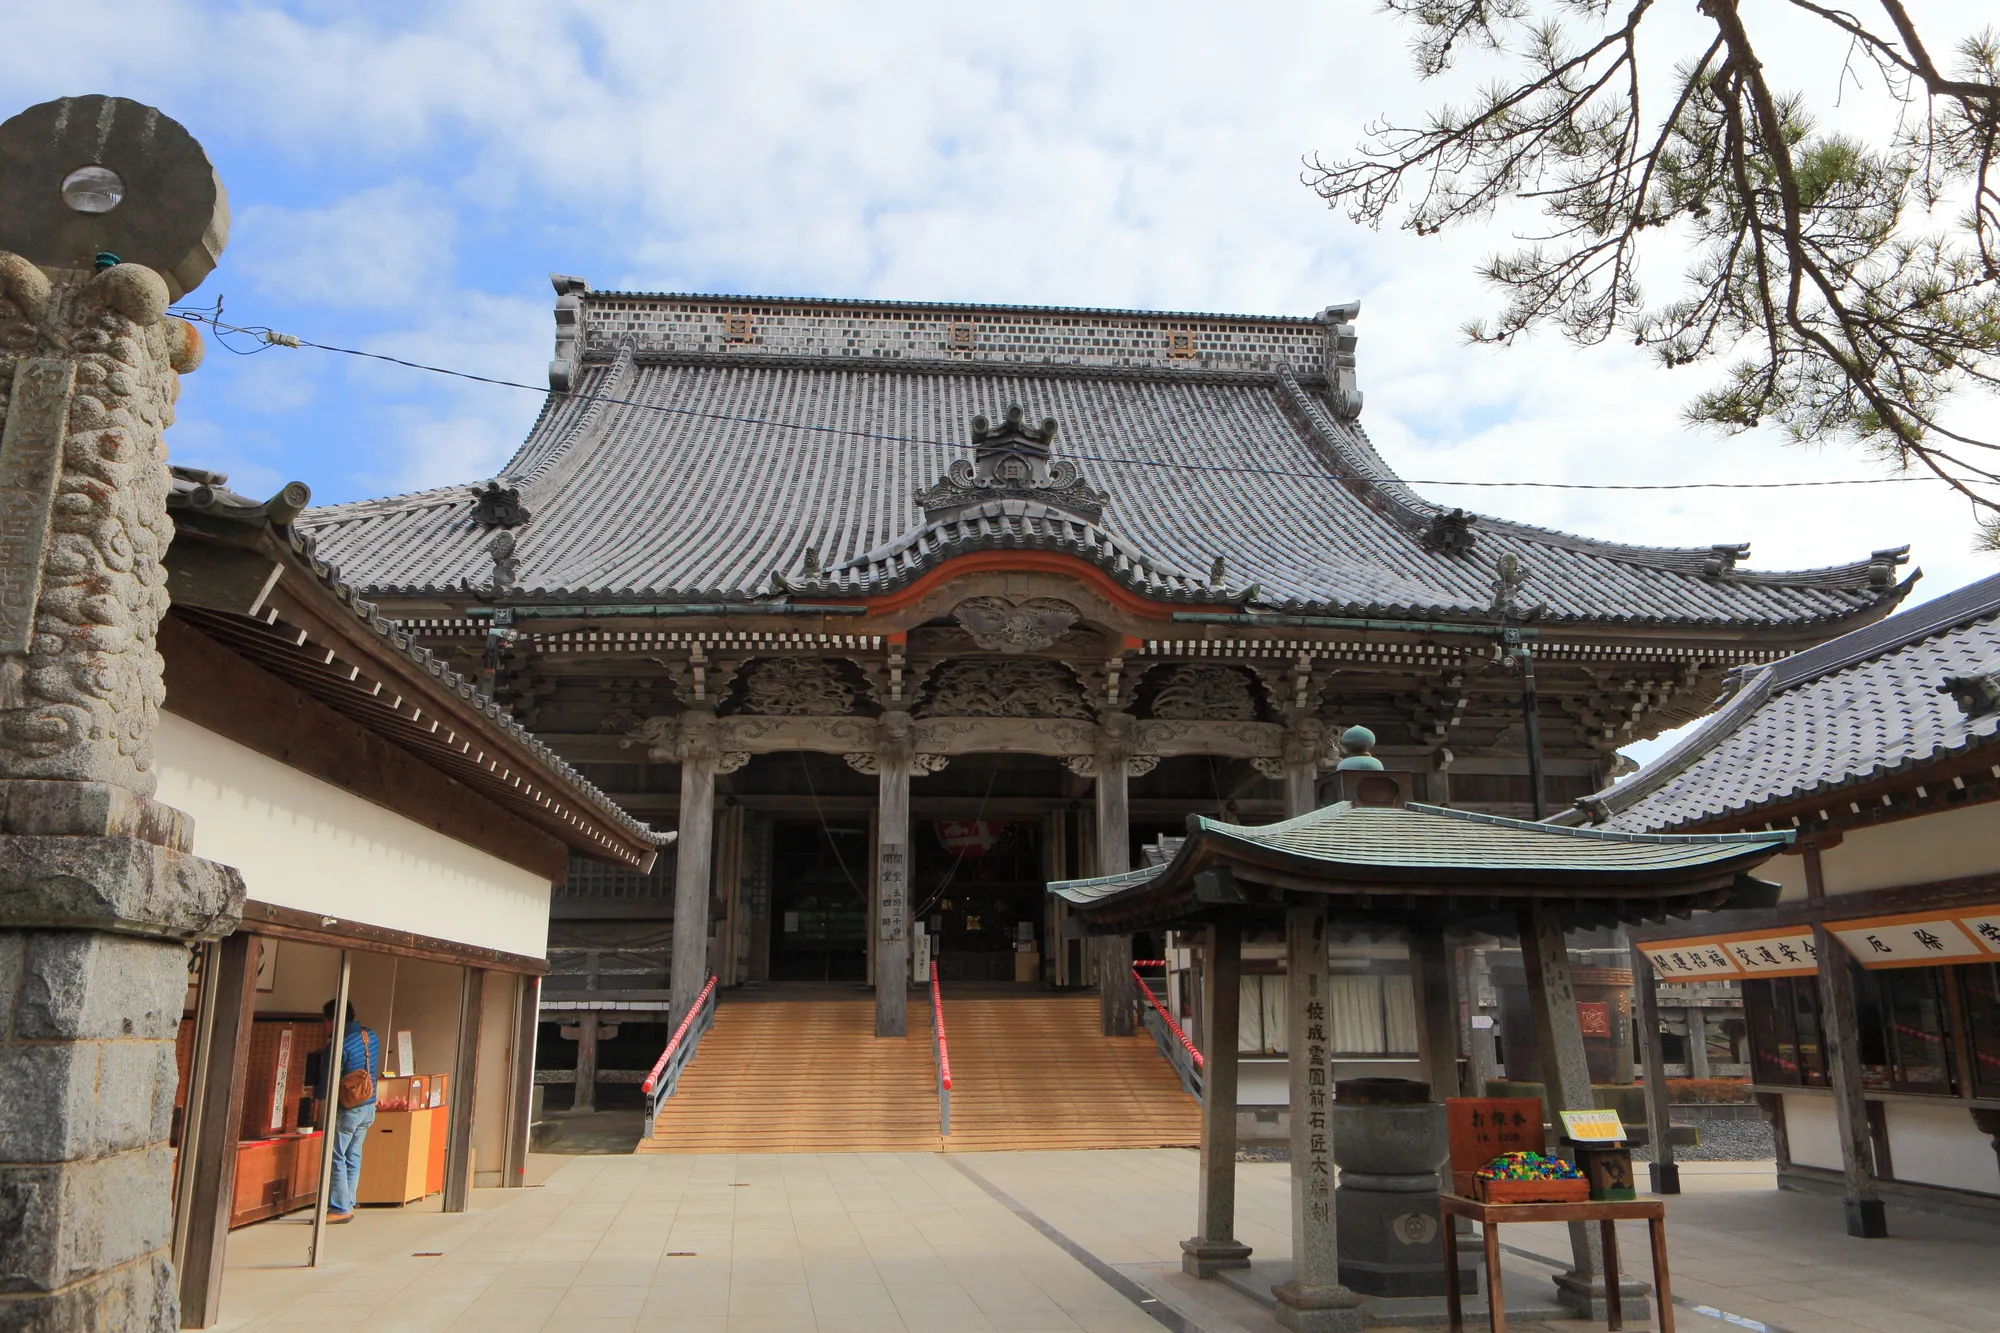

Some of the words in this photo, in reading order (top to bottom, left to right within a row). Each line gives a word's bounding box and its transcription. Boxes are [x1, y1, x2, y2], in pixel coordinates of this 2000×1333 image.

[1736, 940, 1817, 966] 交通安全
[1866, 929, 1944, 953] 厄除
[1653, 949, 1728, 973] 開運招福
